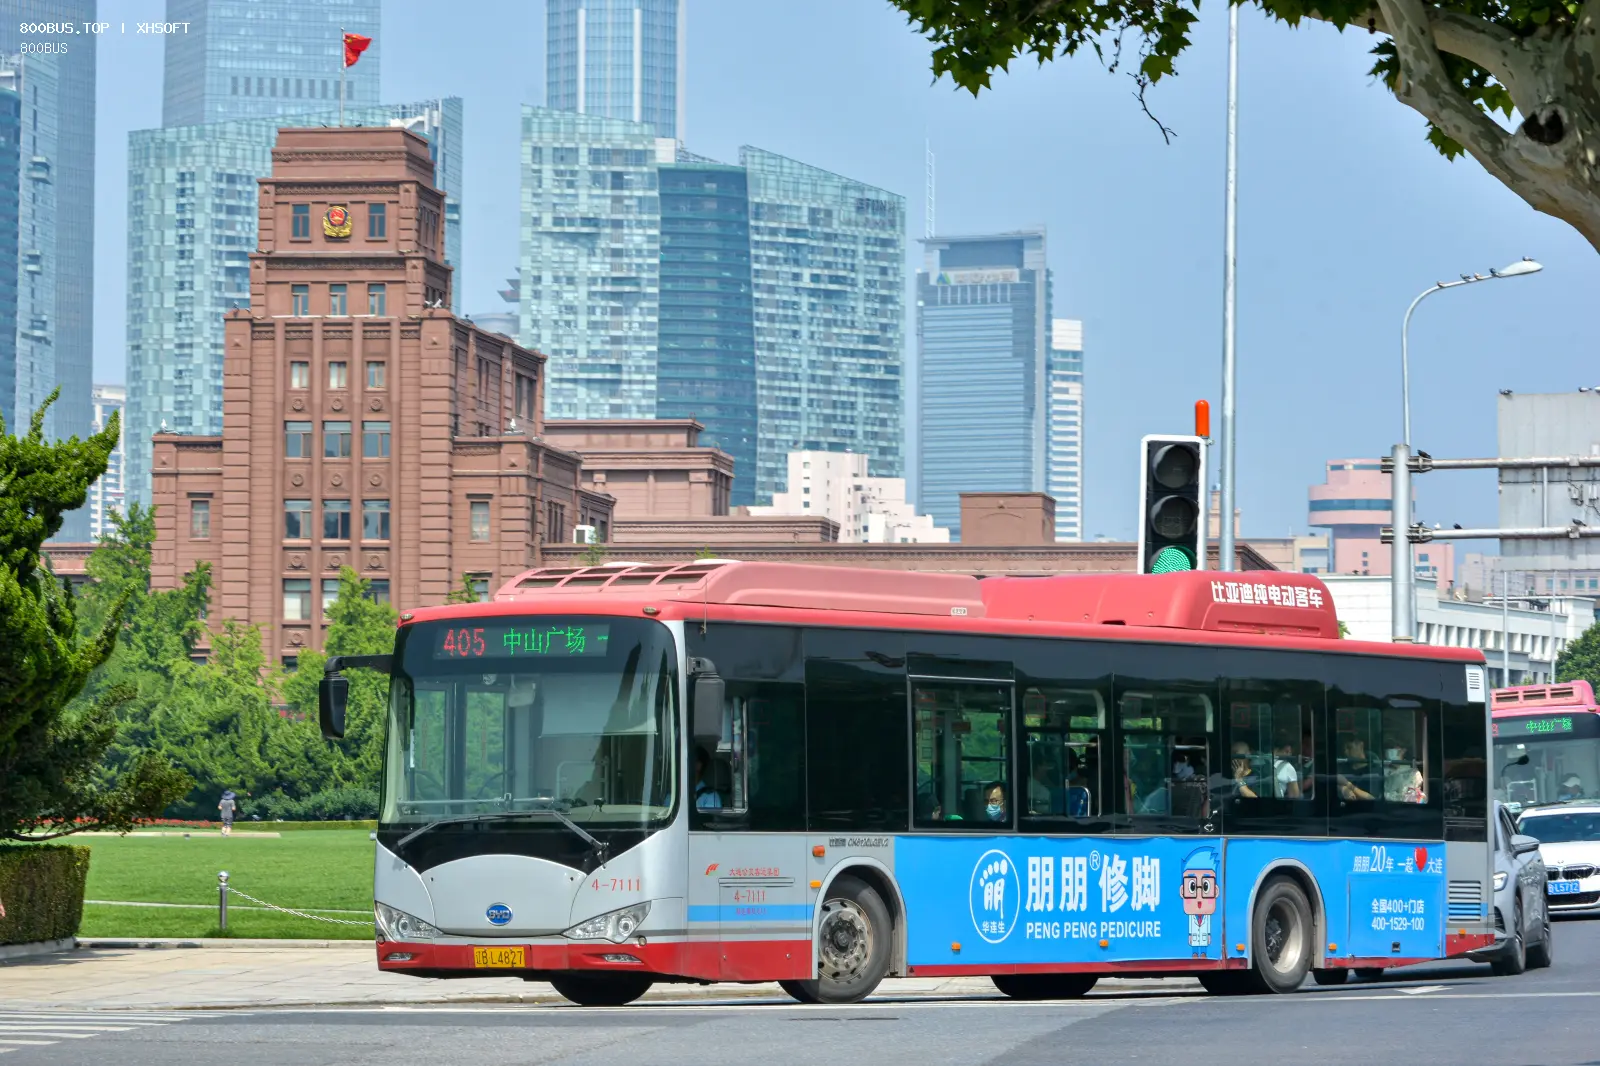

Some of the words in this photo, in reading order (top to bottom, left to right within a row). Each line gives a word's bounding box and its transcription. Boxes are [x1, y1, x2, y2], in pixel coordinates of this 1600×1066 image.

[1210, 580, 1324, 609] 比亚迪纯电动客车
[443, 628, 486, 656] 405
[503, 626, 586, 656] 中山广场
[591, 878, 641, 892] 4-7111
[734, 889, 766, 903] 4-7111
[1371, 898, 1425, 914] 全国400+门店
[488, 909, 510, 919] BYD
[982, 920, 1005, 934] 华连生
[1026, 922, 1061, 939] PENG
[1063, 921, 1097, 938] PENG
[1100, 920, 1162, 938] PEDICURE
[1371, 916, 1425, 931] 400-1529-100
